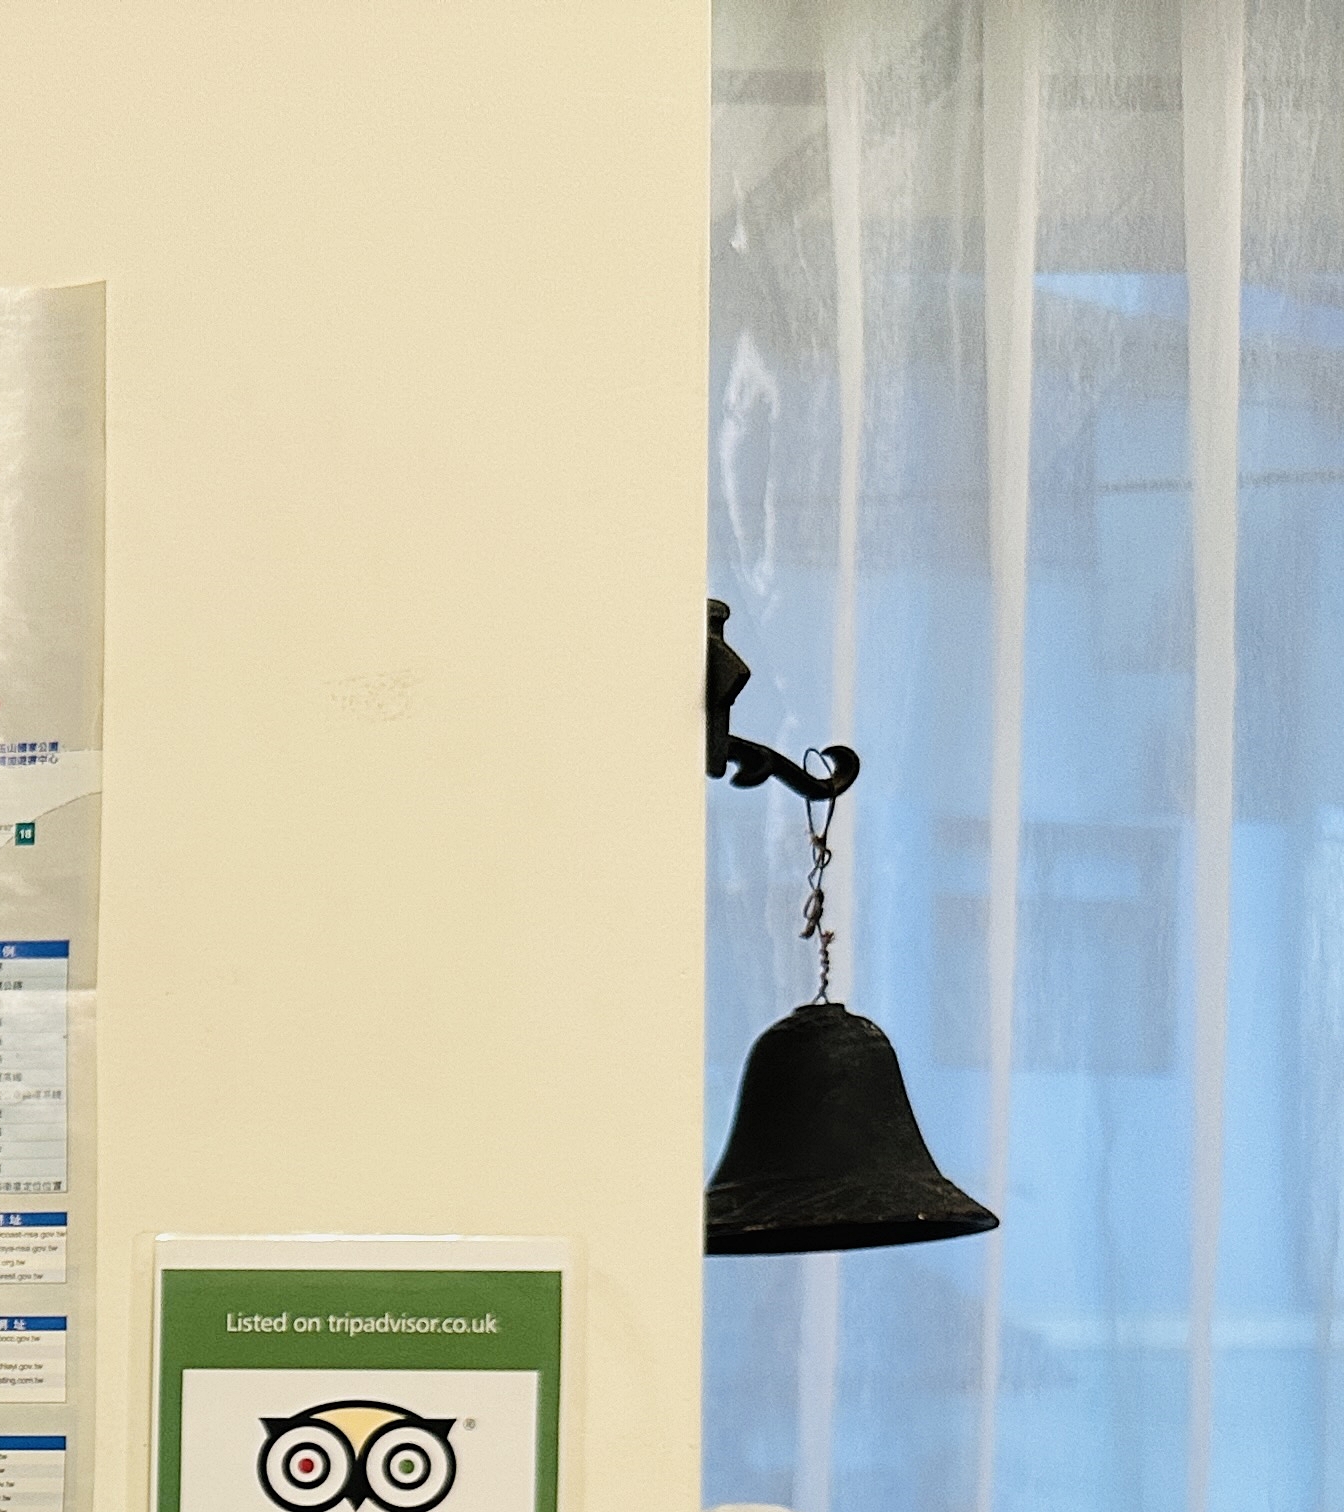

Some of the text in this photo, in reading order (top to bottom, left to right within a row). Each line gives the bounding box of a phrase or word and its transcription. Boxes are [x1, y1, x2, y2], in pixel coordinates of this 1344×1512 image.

[226, 1313, 497, 1336] Listed on tripadvisor.co.uk
